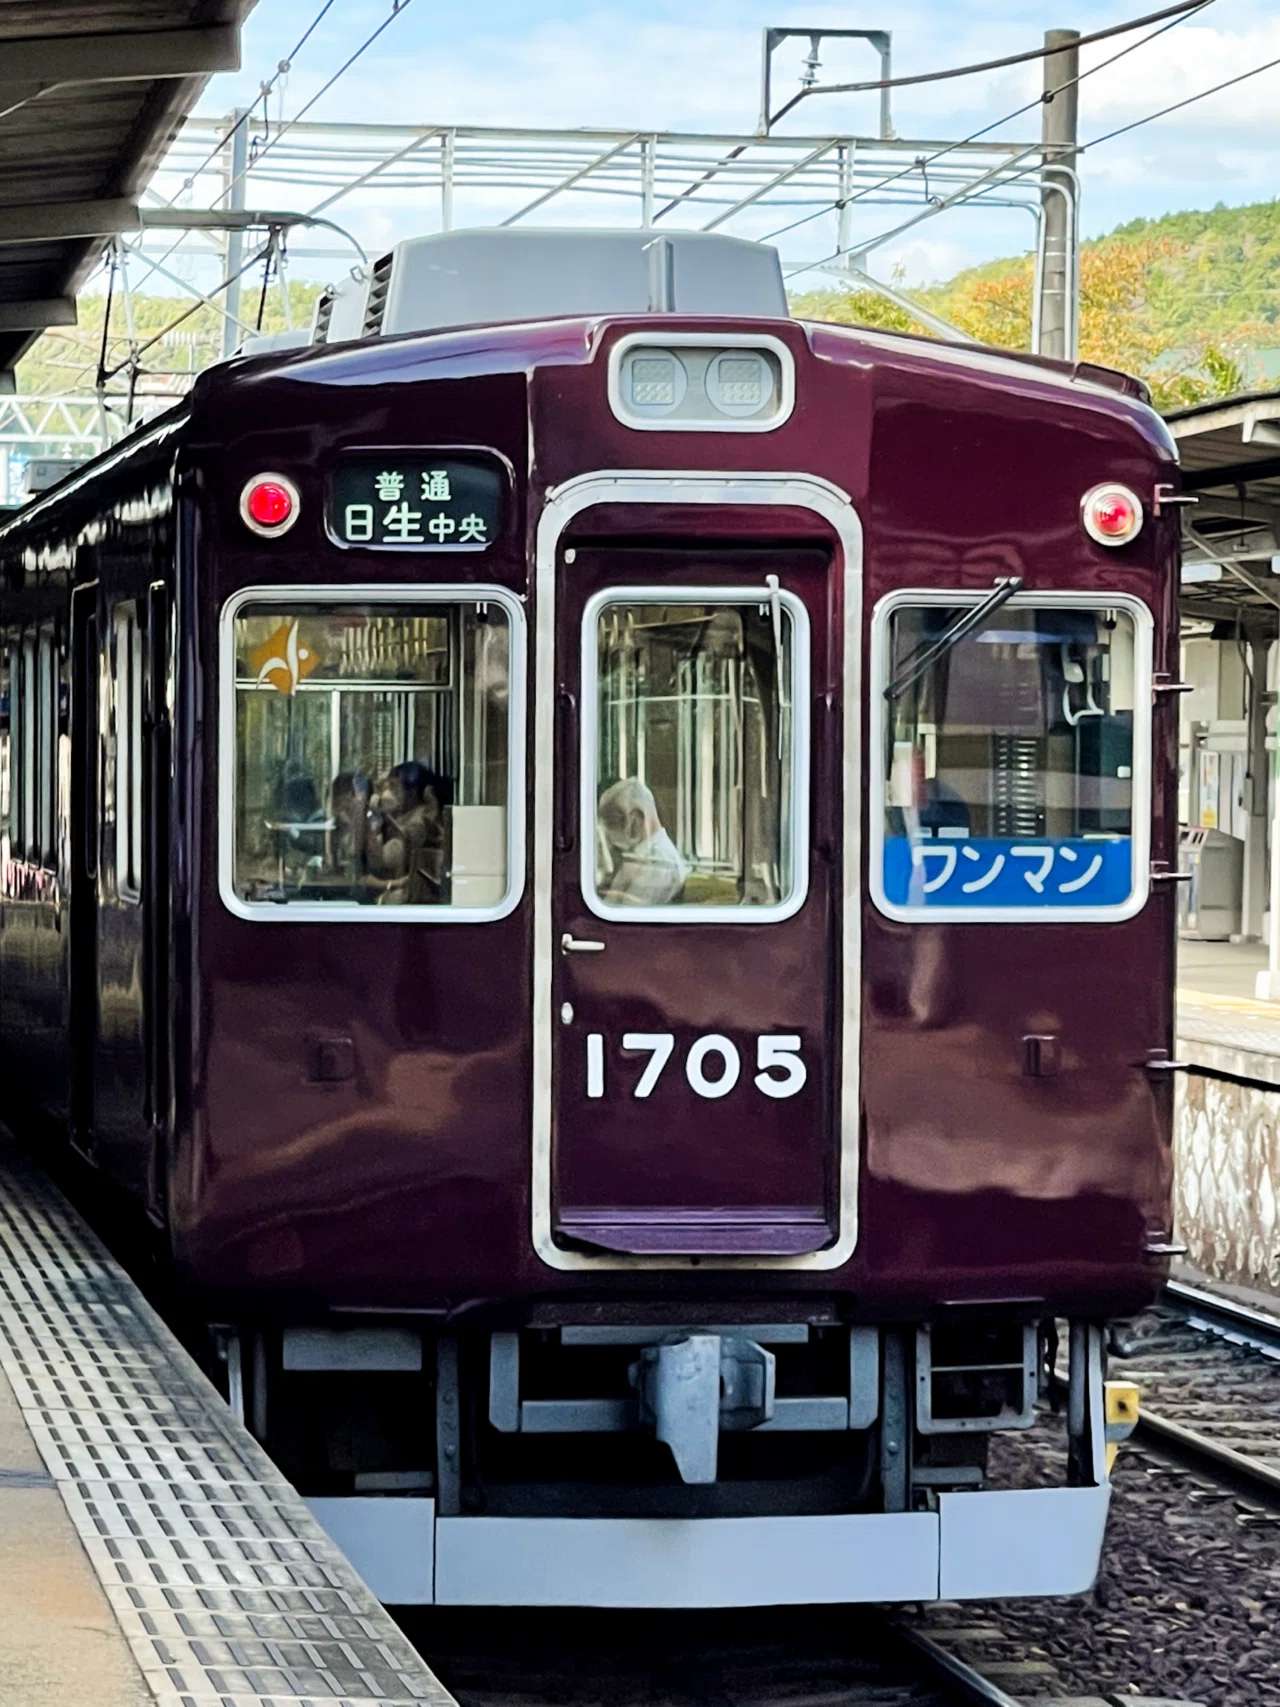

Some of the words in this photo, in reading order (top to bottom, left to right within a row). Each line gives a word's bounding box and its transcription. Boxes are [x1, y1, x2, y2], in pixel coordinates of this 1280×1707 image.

[374, 470, 452, 501] 普通
[345, 501, 487, 543] 日生中央
[913, 845, 1103, 893] ワンマン
[587, 1033, 807, 1098] 1705
